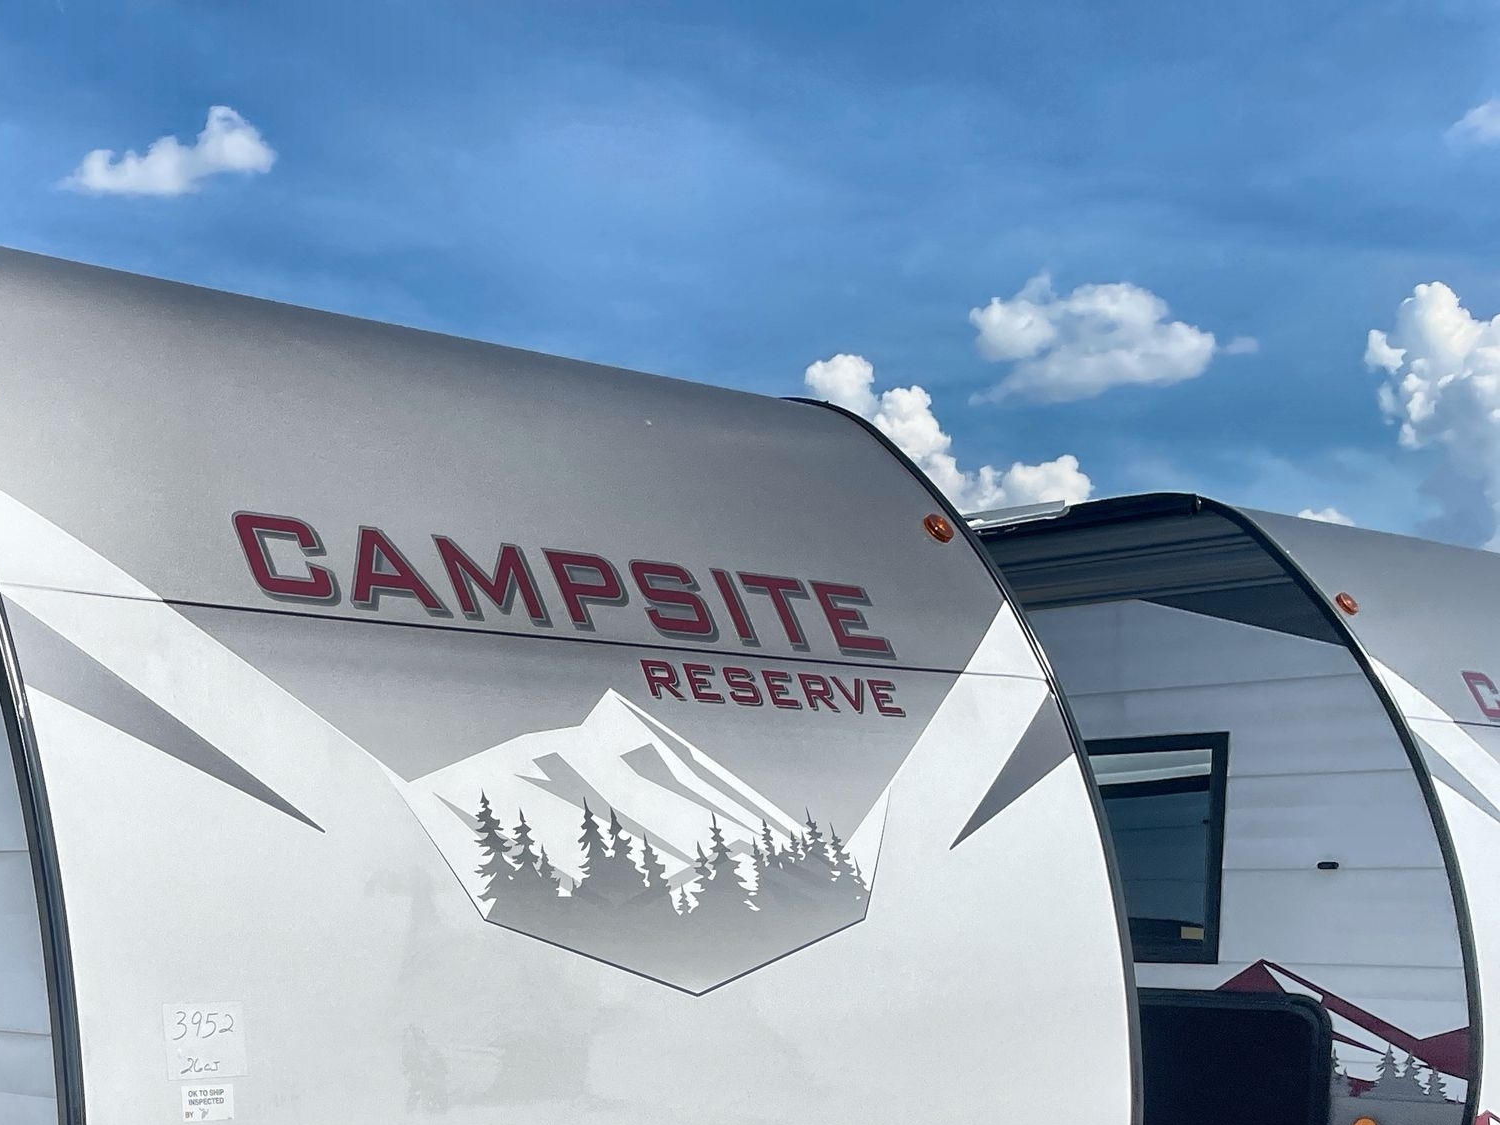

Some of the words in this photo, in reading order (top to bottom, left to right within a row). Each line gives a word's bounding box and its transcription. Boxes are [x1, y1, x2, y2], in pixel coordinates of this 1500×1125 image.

[231, 509, 897, 658] CAMPSITE
[639, 658, 906, 718] RESERVE
[173, 1010, 234, 1041] 3952
[188, 1090, 198, 1098] OK
[209, 1088, 224, 1096] SHIP
[188, 1097, 225, 1106] INSPECTED
[185, 1111, 194, 1119] BY
